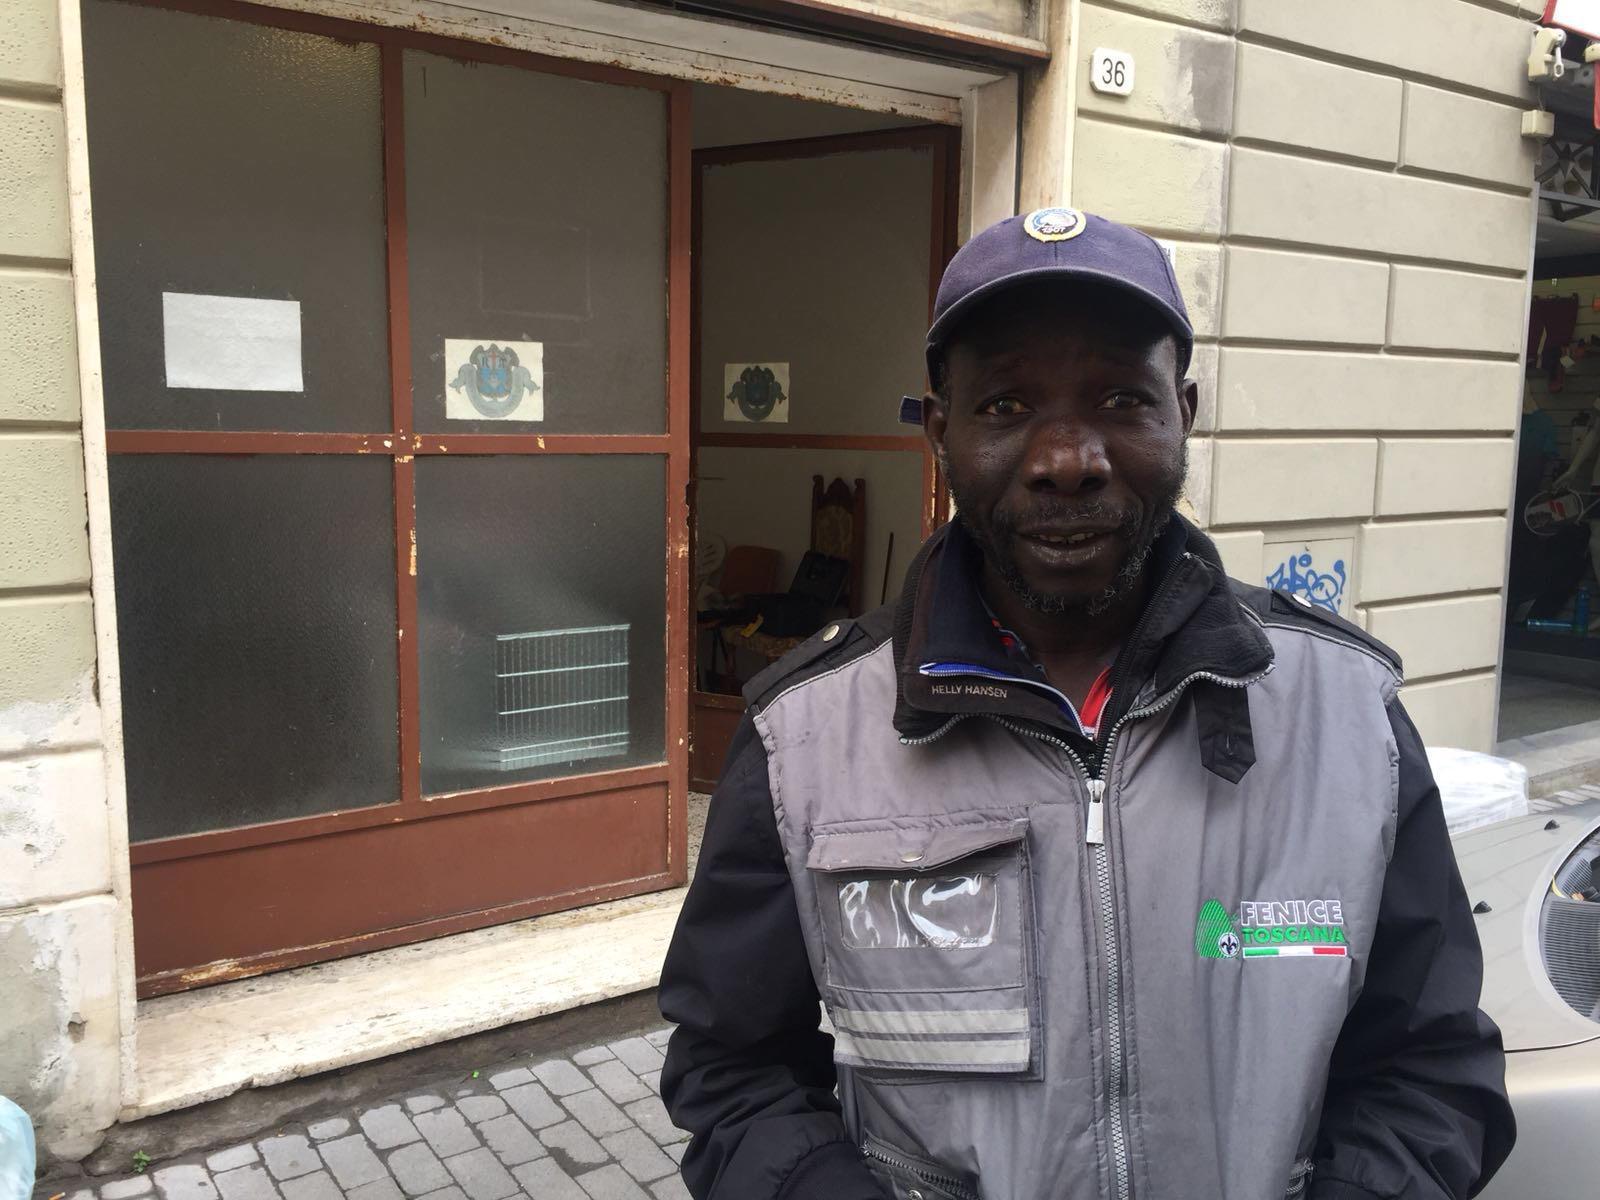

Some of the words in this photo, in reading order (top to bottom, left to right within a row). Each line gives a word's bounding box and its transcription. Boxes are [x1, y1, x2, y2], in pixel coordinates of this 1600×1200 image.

[1102, 57, 1126, 88] 36
[931, 685, 963, 695] HELLY
[965, 686, 1008, 699] HANSEN
[1240, 899, 1344, 926] FENICE
[1241, 926, 1346, 944] TOSCANA
